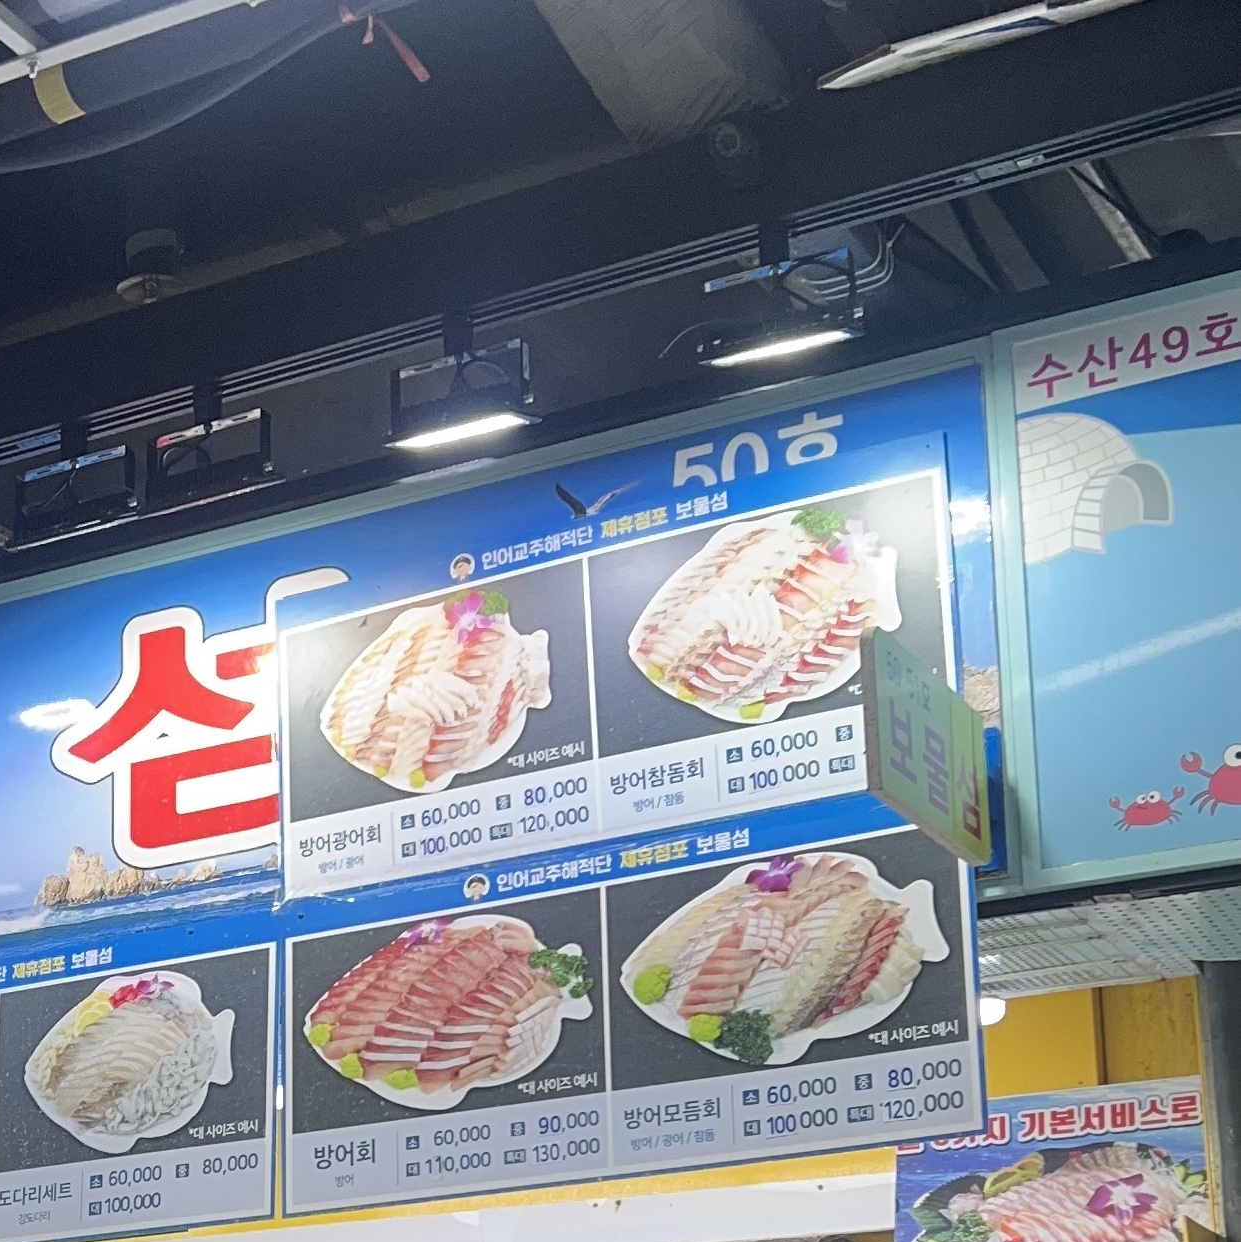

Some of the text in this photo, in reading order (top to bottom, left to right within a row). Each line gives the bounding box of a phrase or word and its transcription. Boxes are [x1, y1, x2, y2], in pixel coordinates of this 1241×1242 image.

[1027, 312, 1241, 398] 수산49호
[481, 490, 729, 571] 인어교주해적단 제휴점포 보물섬
[526, 747, 560, 766] 사이즈
[561, 741, 586, 758] 예시
[751, 729, 819, 758] 60,000
[609, 757, 705, 795] 방어참돔회
[889, 696, 983, 840] 보물섬
[420, 799, 482, 828] 60,000
[524, 776, 589, 806] 80,000
[299, 823, 381, 858] 방어광어회
[420, 827, 483, 855] 100,000
[517, 805, 590, 834] 120,000
[496, 855, 613, 892] 인어교주해적단
[697, 828, 751, 855] 보물섬
[71, 947, 113, 969] 보물섬
[890, 1024, 931, 1045] 사이즈
[931, 1019, 960, 1038] 예시
[537, 1076, 573, 1094] 사이즈
[573, 1071, 599, 1089] 예시
[766, 1076, 838, 1105] 60,000
[887, 1057, 963, 1088] 80,000
[623, 1096, 722, 1130] 방어모듬회
[882, 1089, 966, 1119] 120,000
[1019, 1094, 1202, 1142] 기본서비스로
[205, 1122, 237, 1138] 사이즈
[237, 1118, 259, 1133] 예시
[433, 1124, 492, 1151] 60,000
[537, 1110, 600, 1136] 90,000
[630, 1134, 653, 1150] 방어
[108, 1165, 163, 1189] 60,000
[202, 1152, 259, 1177] 80,000
[314, 1138, 377, 1171] 방어회
[424, 1151, 492, 1178] 110,000
[532, 1137, 601, 1164] 130,000
[334, 1173, 355, 1187] 방어
[104, 1192, 162, 1215] 100,000
